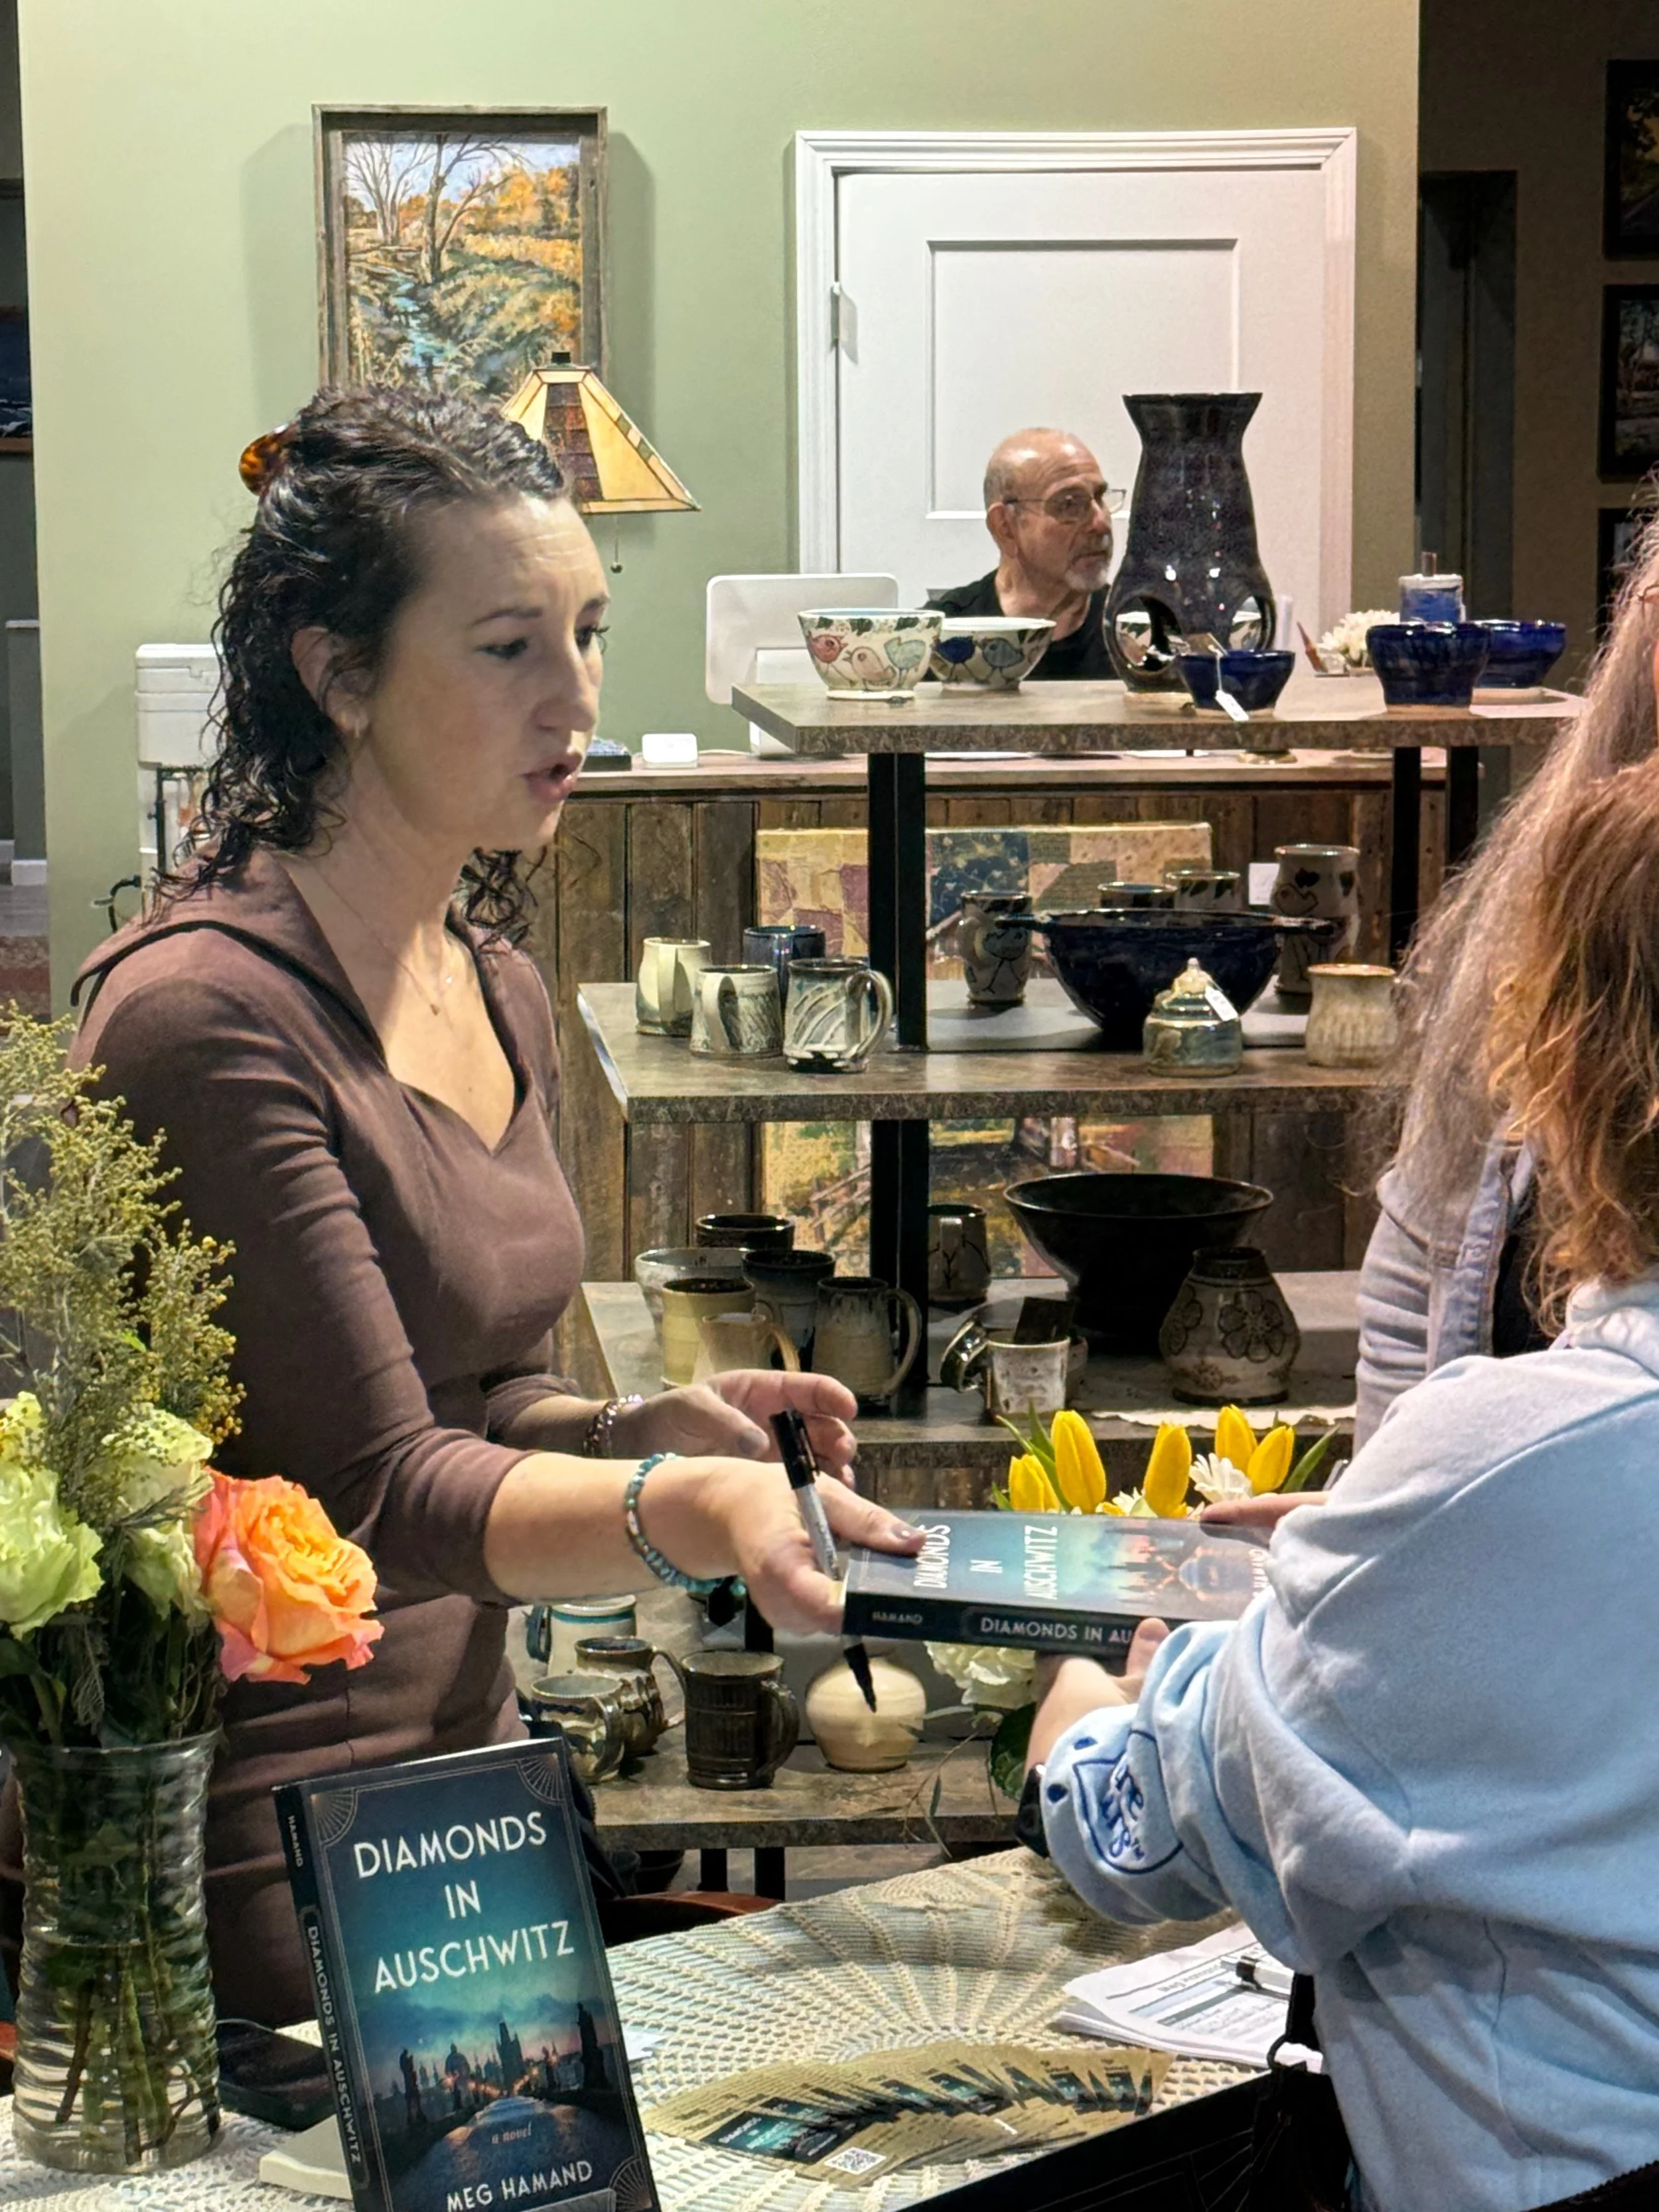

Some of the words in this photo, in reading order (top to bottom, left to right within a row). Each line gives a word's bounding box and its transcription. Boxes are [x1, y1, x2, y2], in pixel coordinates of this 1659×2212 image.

[970, 1559, 1003, 1574] IN
[1023, 1525, 1058, 1599] AUSCHWITZ
[872, 1610, 923, 1625] HAMAND
[980, 1616, 1078, 1640] DIAMONDS
[1084, 1626, 1103, 1642] IN
[287, 1815, 304, 1868] HAMAND
[354, 1811, 547, 1879] DIAMONDS
[444, 1880, 482, 1919] IN
[308, 1926, 335, 2026] DIAMONDS
[374, 1920, 575, 1994] AUSCHWITZ
[328, 2033, 340, 2052] IN
[333, 2059, 361, 2163] AUSCHWITZ
[447, 2183, 493, 2212] MEG
[501, 2161, 593, 2201] HAMAND
